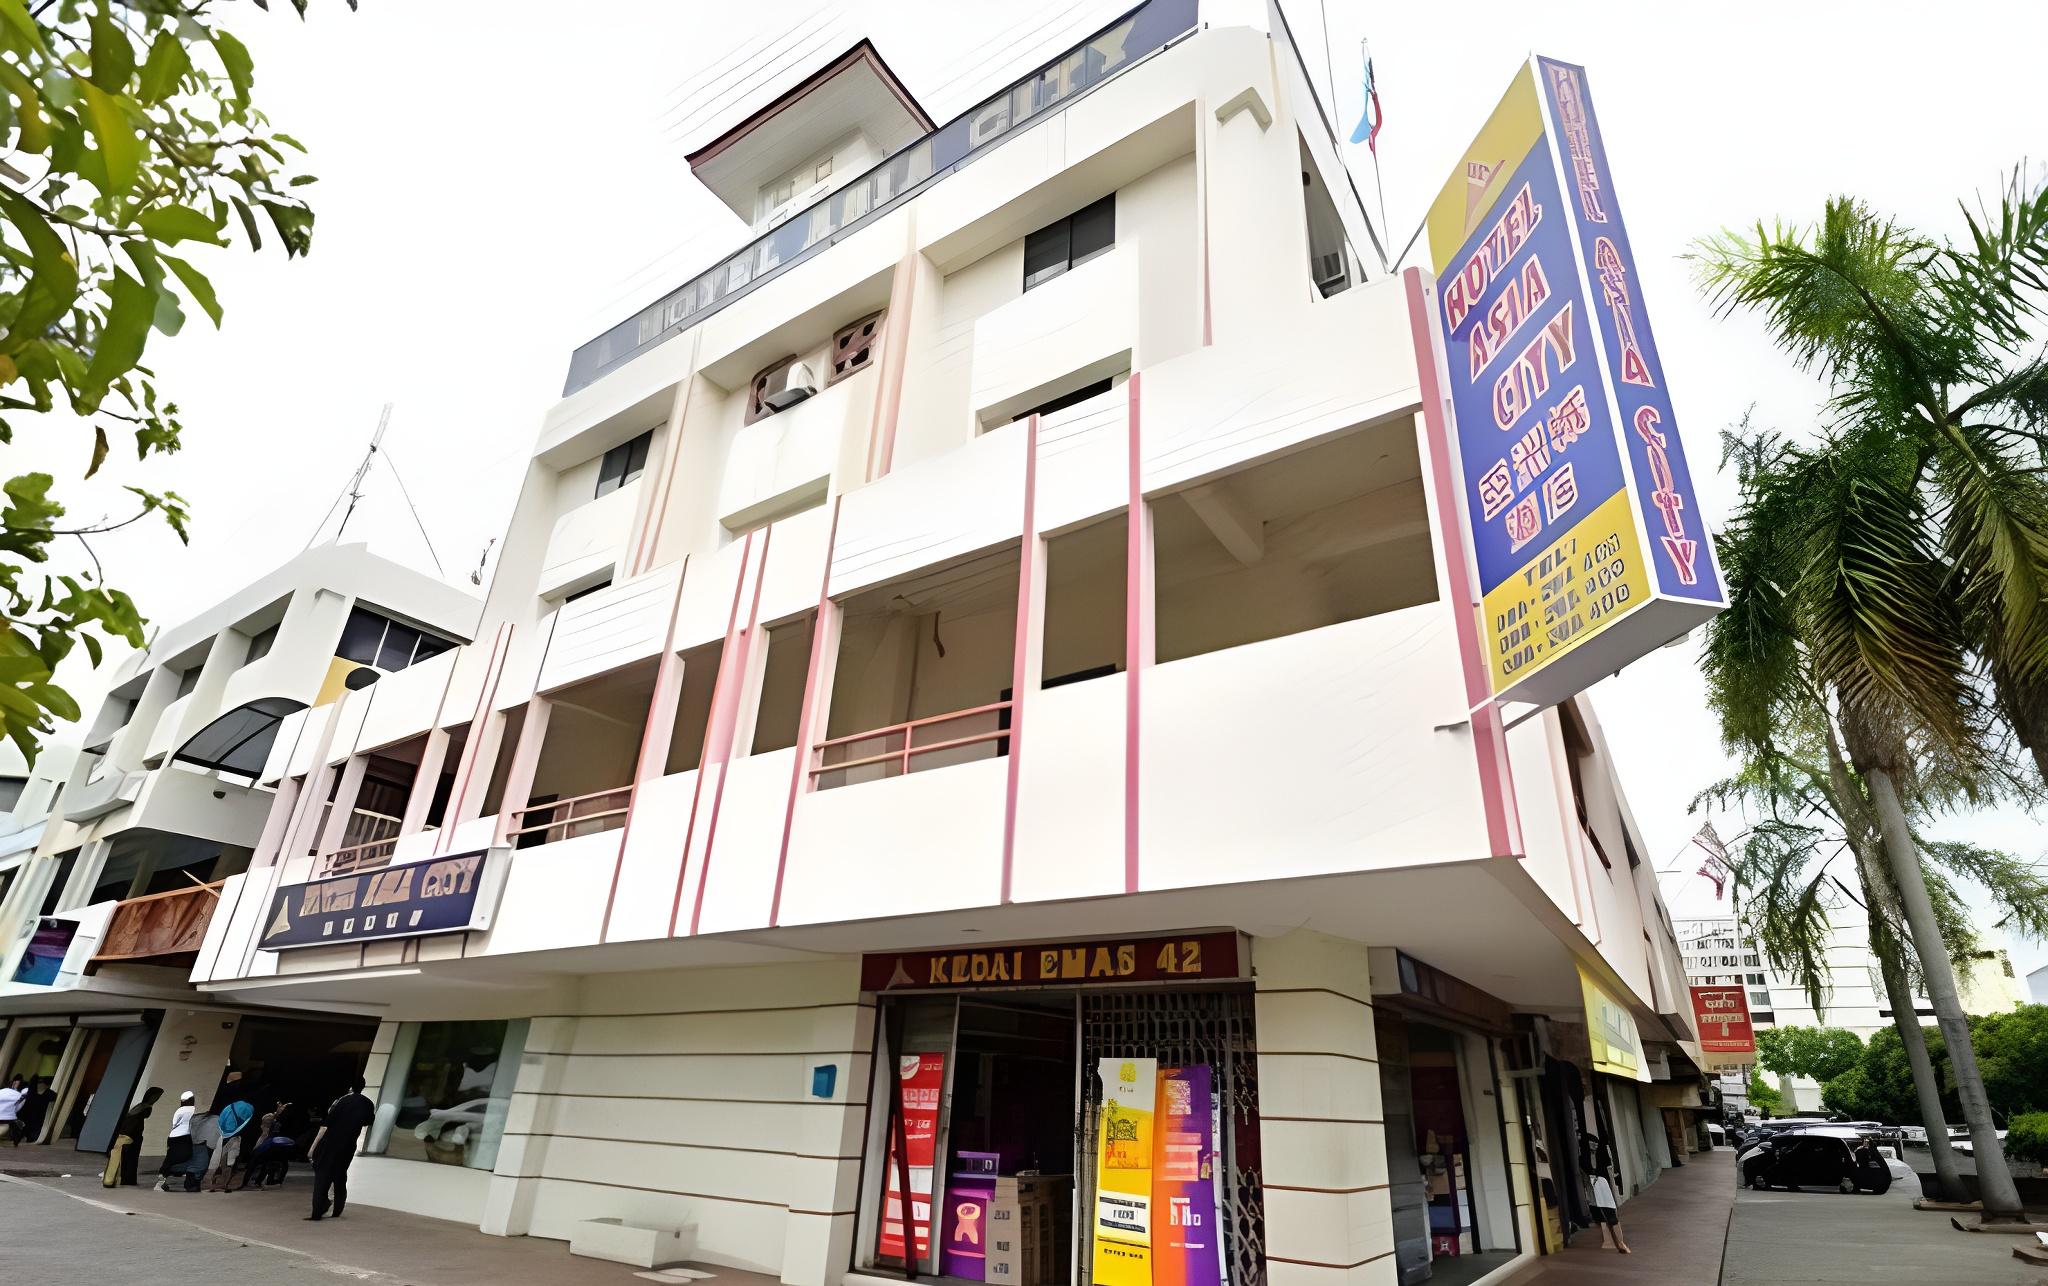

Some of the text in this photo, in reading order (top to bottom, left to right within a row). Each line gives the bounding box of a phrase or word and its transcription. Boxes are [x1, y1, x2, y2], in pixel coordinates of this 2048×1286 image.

[1470, 253, 1552, 384] ASIA
[1634, 405, 1697, 585] CITY
[929, 951, 1023, 984] KEDAI
[1156, 941, 1202, 973] 42
